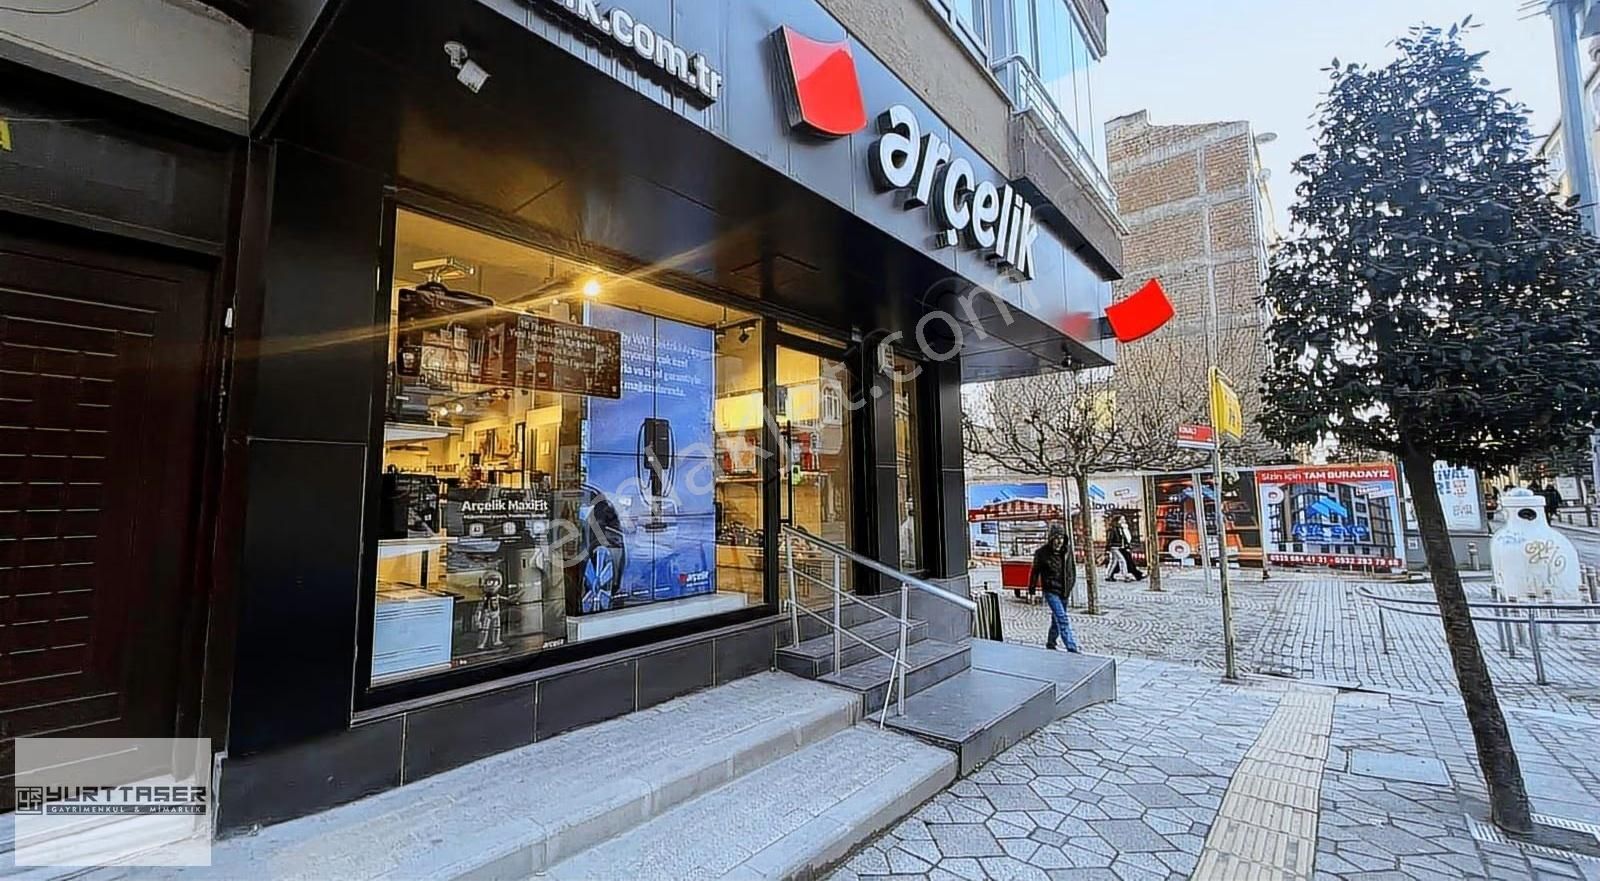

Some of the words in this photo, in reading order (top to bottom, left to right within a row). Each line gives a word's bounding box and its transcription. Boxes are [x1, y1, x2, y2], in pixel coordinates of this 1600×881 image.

[565, 0, 722, 99] k.com.tr
[878, 104, 1039, 281] arçelik
[1261, 472, 1283, 481] Sizin
[1284, 472, 1302, 482] için
[1303, 471, 1326, 480] TAM
[1327, 469, 1391, 480] BURADAYIZ
[461, 500, 506, 514] Arçelik
